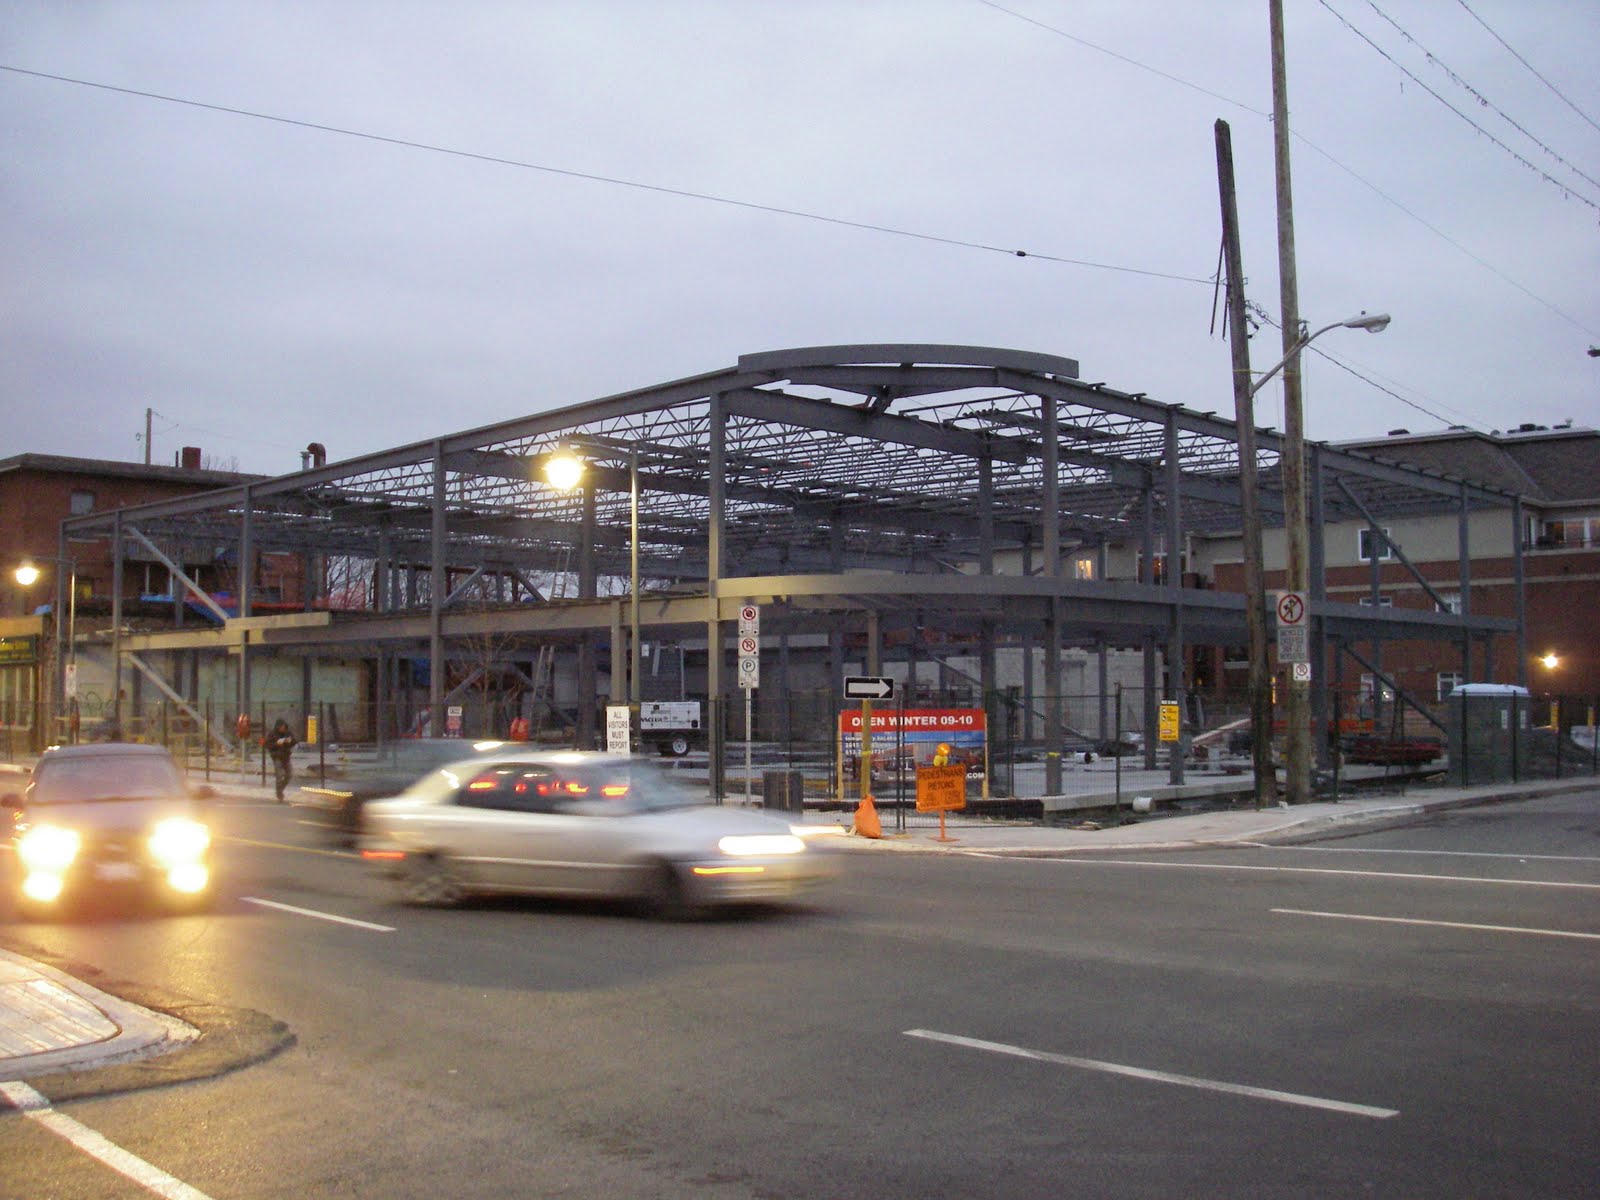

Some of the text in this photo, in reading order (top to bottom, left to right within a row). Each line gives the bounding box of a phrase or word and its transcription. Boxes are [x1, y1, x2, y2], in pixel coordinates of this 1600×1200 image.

[613, 711, 622, 719] ALL
[608, 720, 628, 729] VISITORS
[888, 716, 937, 726] WINTER
[940, 715, 974, 725] 09-10
[611, 731, 624, 739] MUST
[609, 741, 627, 749] REPORT
